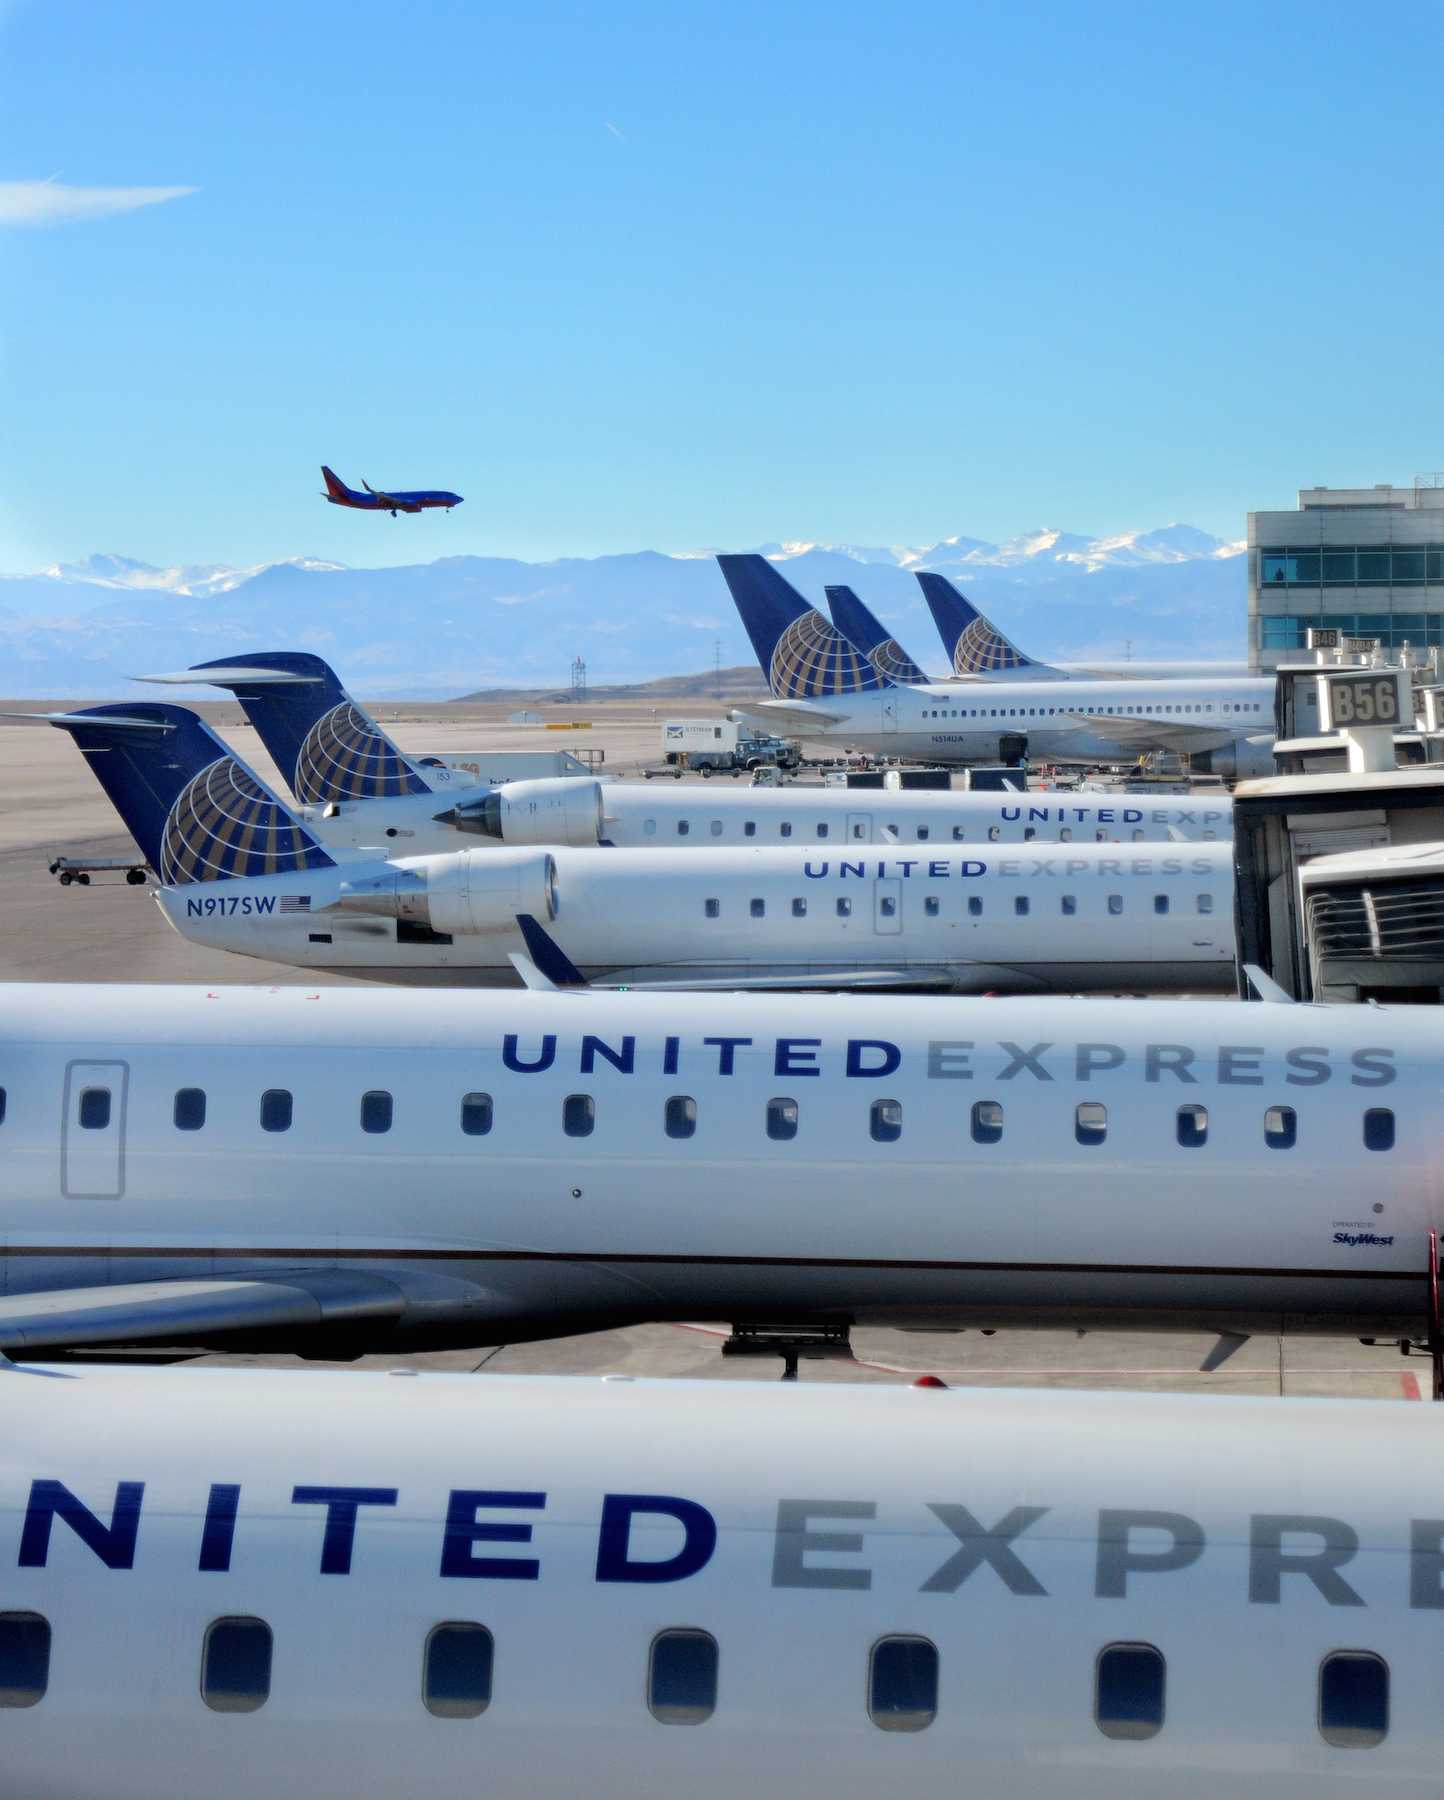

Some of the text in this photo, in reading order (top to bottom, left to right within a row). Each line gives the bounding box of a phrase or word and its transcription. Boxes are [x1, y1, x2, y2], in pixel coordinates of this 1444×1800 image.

[1312, 631, 1336, 646] B46
[1332, 681, 1395, 721] B56
[1001, 807, 1232, 825] UNITED EXP
[804, 858, 1213, 879] UNITED EXPRESS
[187, 896, 276, 917] N917SW
[502, 1034, 1397, 1087] UNITED EXPRESS
[1332, 1232, 1394, 1246] SkyWest
